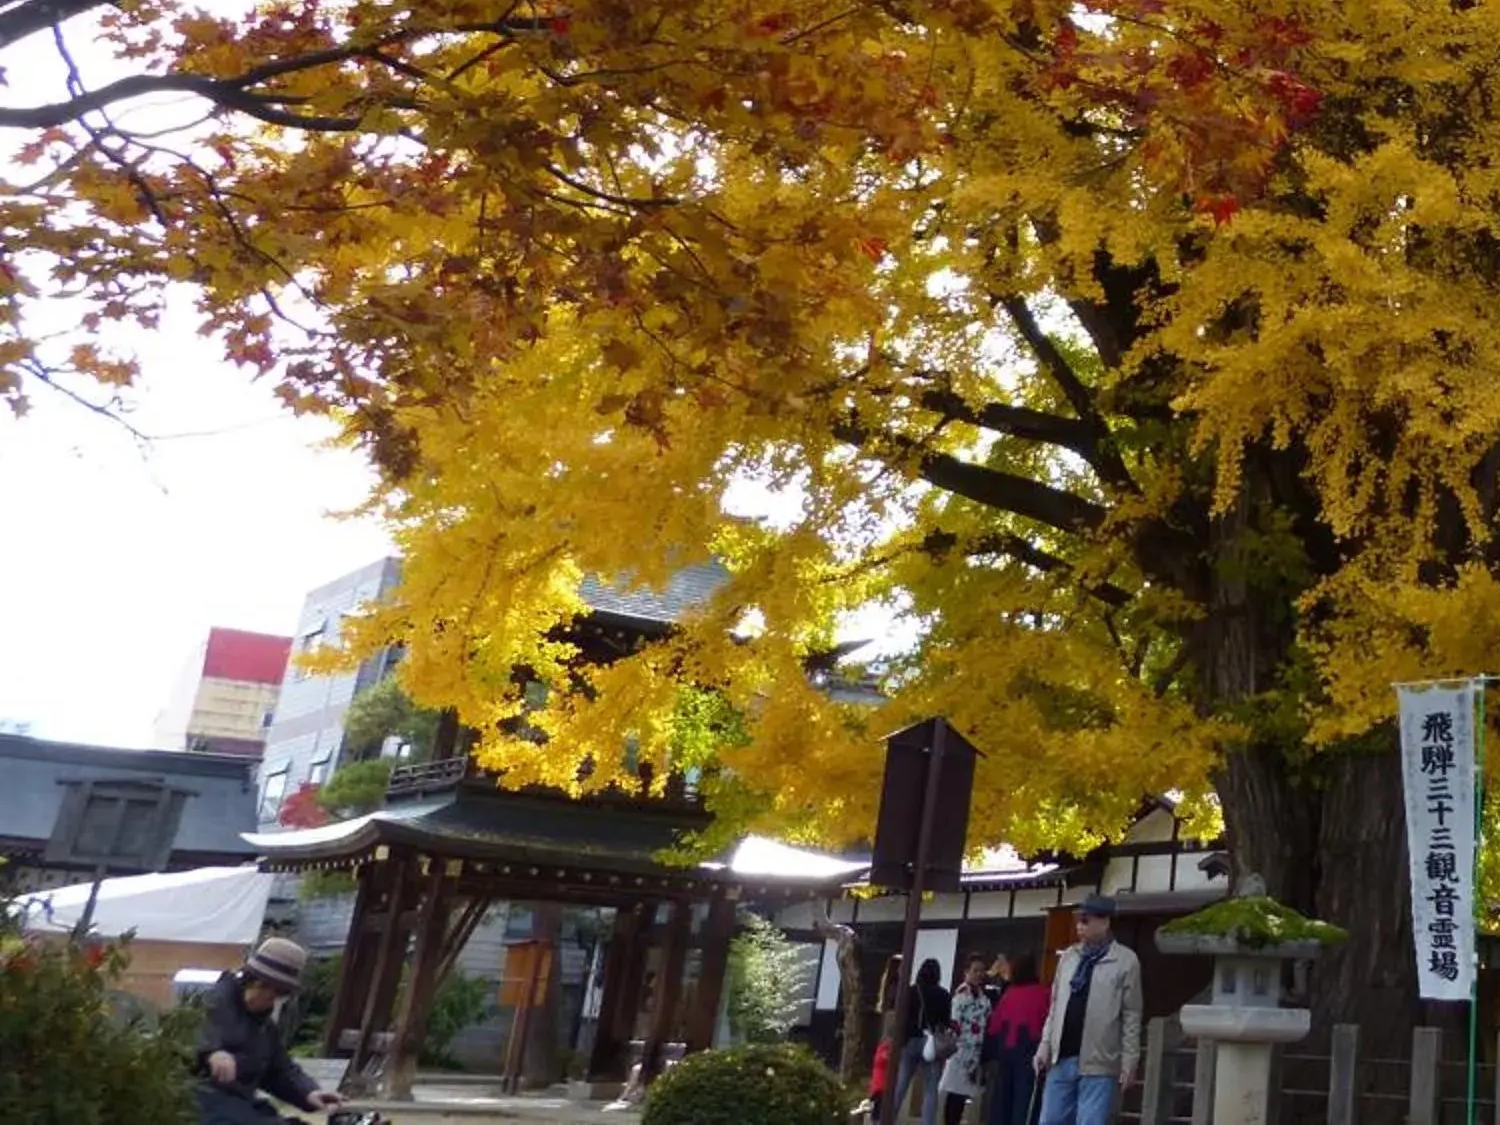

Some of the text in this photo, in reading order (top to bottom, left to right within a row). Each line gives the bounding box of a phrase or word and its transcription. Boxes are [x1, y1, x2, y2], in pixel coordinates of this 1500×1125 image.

[1420, 711, 1460, 982] 飛騨三十三観音霊場
